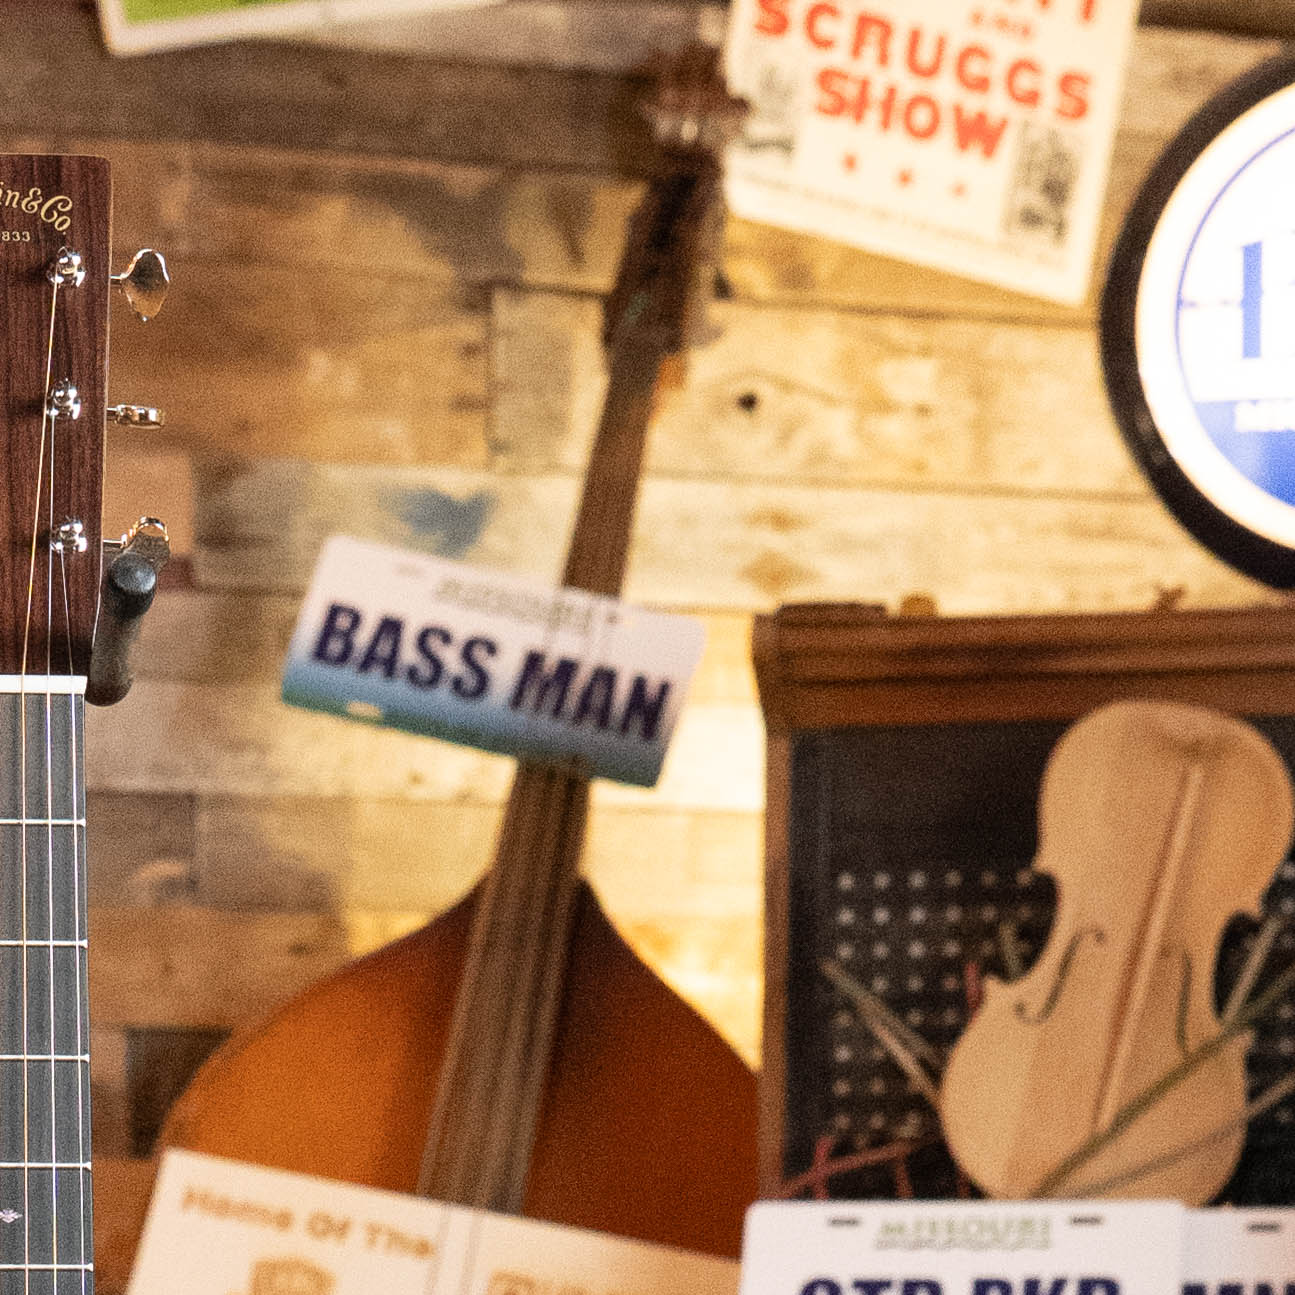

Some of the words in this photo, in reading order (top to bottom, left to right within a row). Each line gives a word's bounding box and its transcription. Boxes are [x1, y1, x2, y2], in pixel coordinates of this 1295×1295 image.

[753, 0, 1092, 120] SCRUGGS
[816, 68, 1008, 160] SHOW
[311, 601, 498, 702] BASS
[507, 648, 672, 742] MAN
